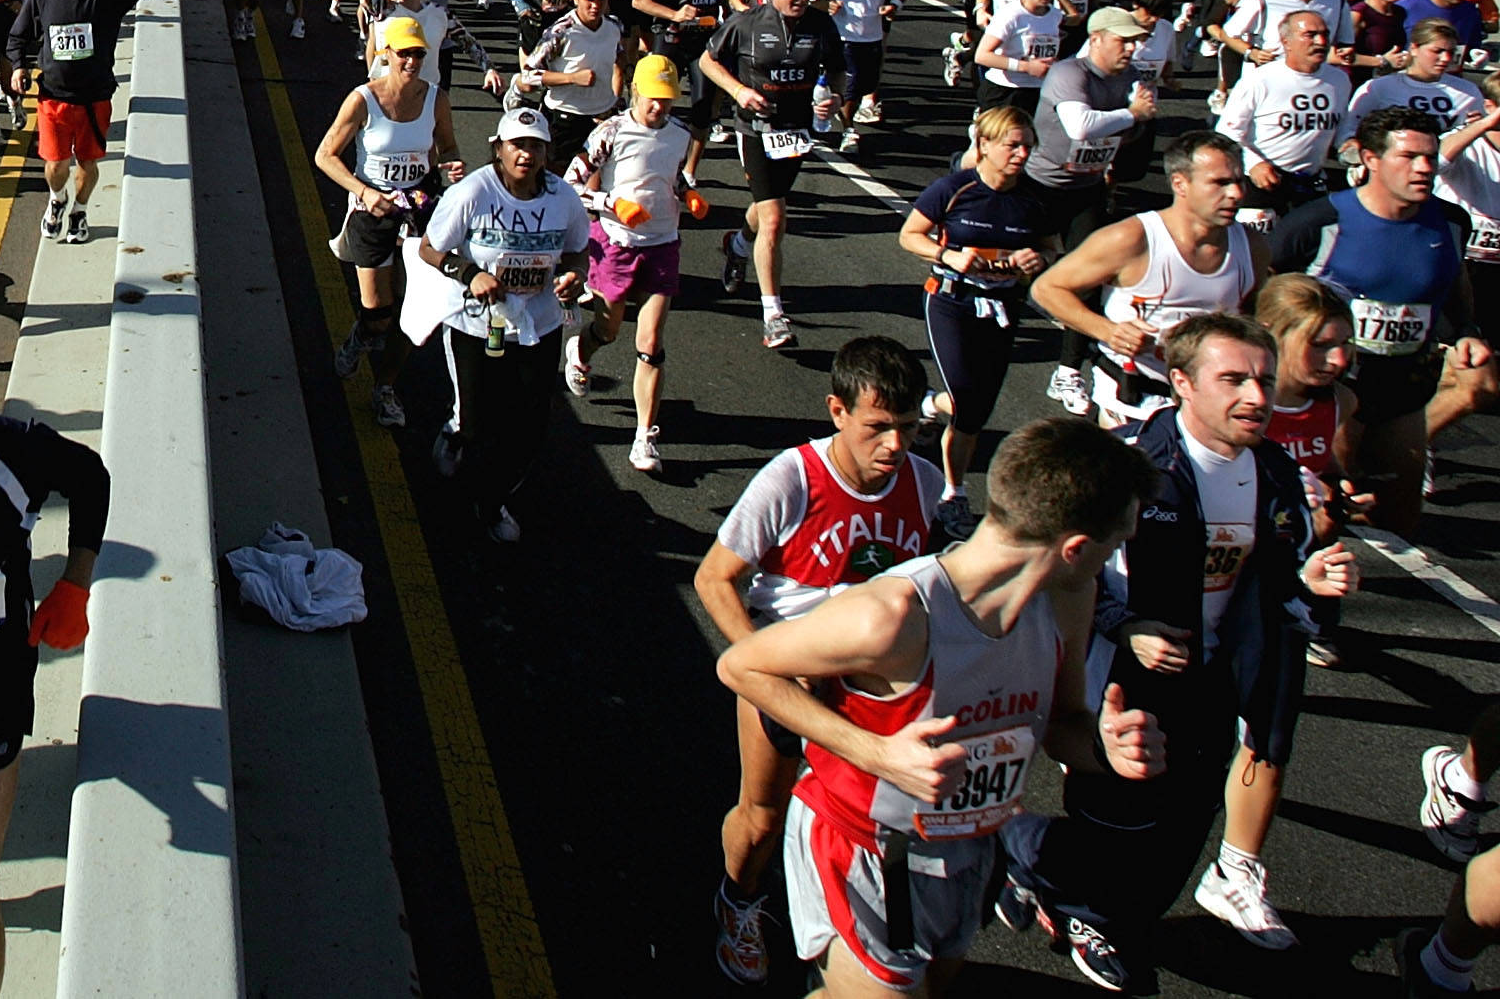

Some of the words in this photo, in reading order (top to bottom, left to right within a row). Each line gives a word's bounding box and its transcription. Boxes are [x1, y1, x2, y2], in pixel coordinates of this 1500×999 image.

[57, 33, 86, 51] 3718
[770, 68, 805, 82] KEES
[1291, 93, 1331, 112] GO
[1408, 95, 1453, 113] GO
[1278, 112, 1342, 131] GLENN
[490, 203, 546, 233] KAY
[507, 256, 530, 266] ING
[811, 512, 922, 568] ITALIA
[956, 690, 1040, 728] COLIN
[964, 741, 991, 763] NG
[933, 758, 1025, 812] 3947
